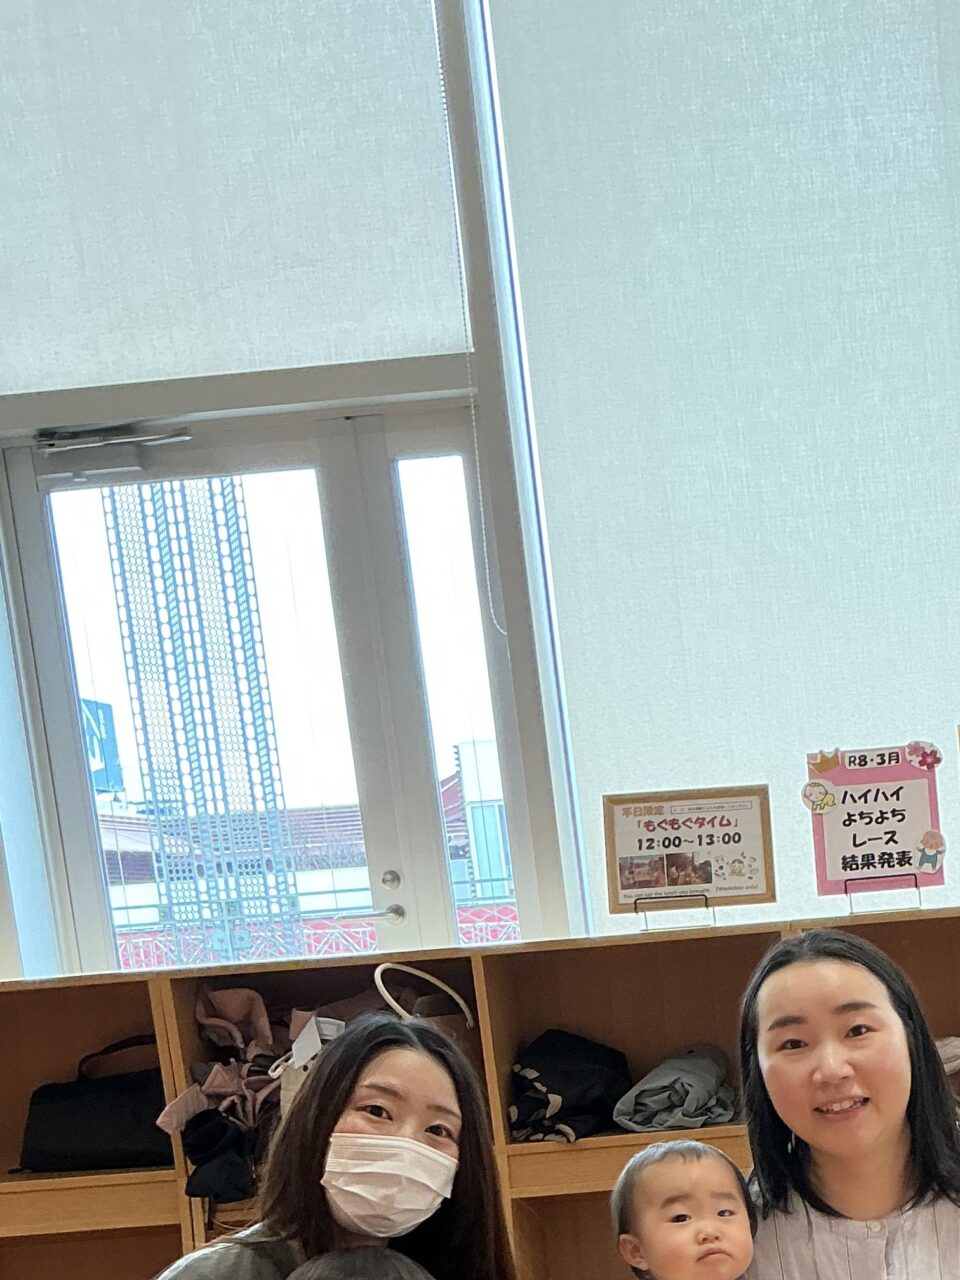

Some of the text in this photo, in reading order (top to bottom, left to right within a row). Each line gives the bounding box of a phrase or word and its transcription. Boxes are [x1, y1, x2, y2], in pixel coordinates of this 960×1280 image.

[841, 785, 904, 804] ハイハイ
[621, 805, 665, 818] 平日限定
[842, 808, 906, 827] よちよち
[637, 815, 739, 832] 「もぐもぐタイム」
[852, 830, 899, 848] レース
[841, 850, 913, 872] 結果発表
